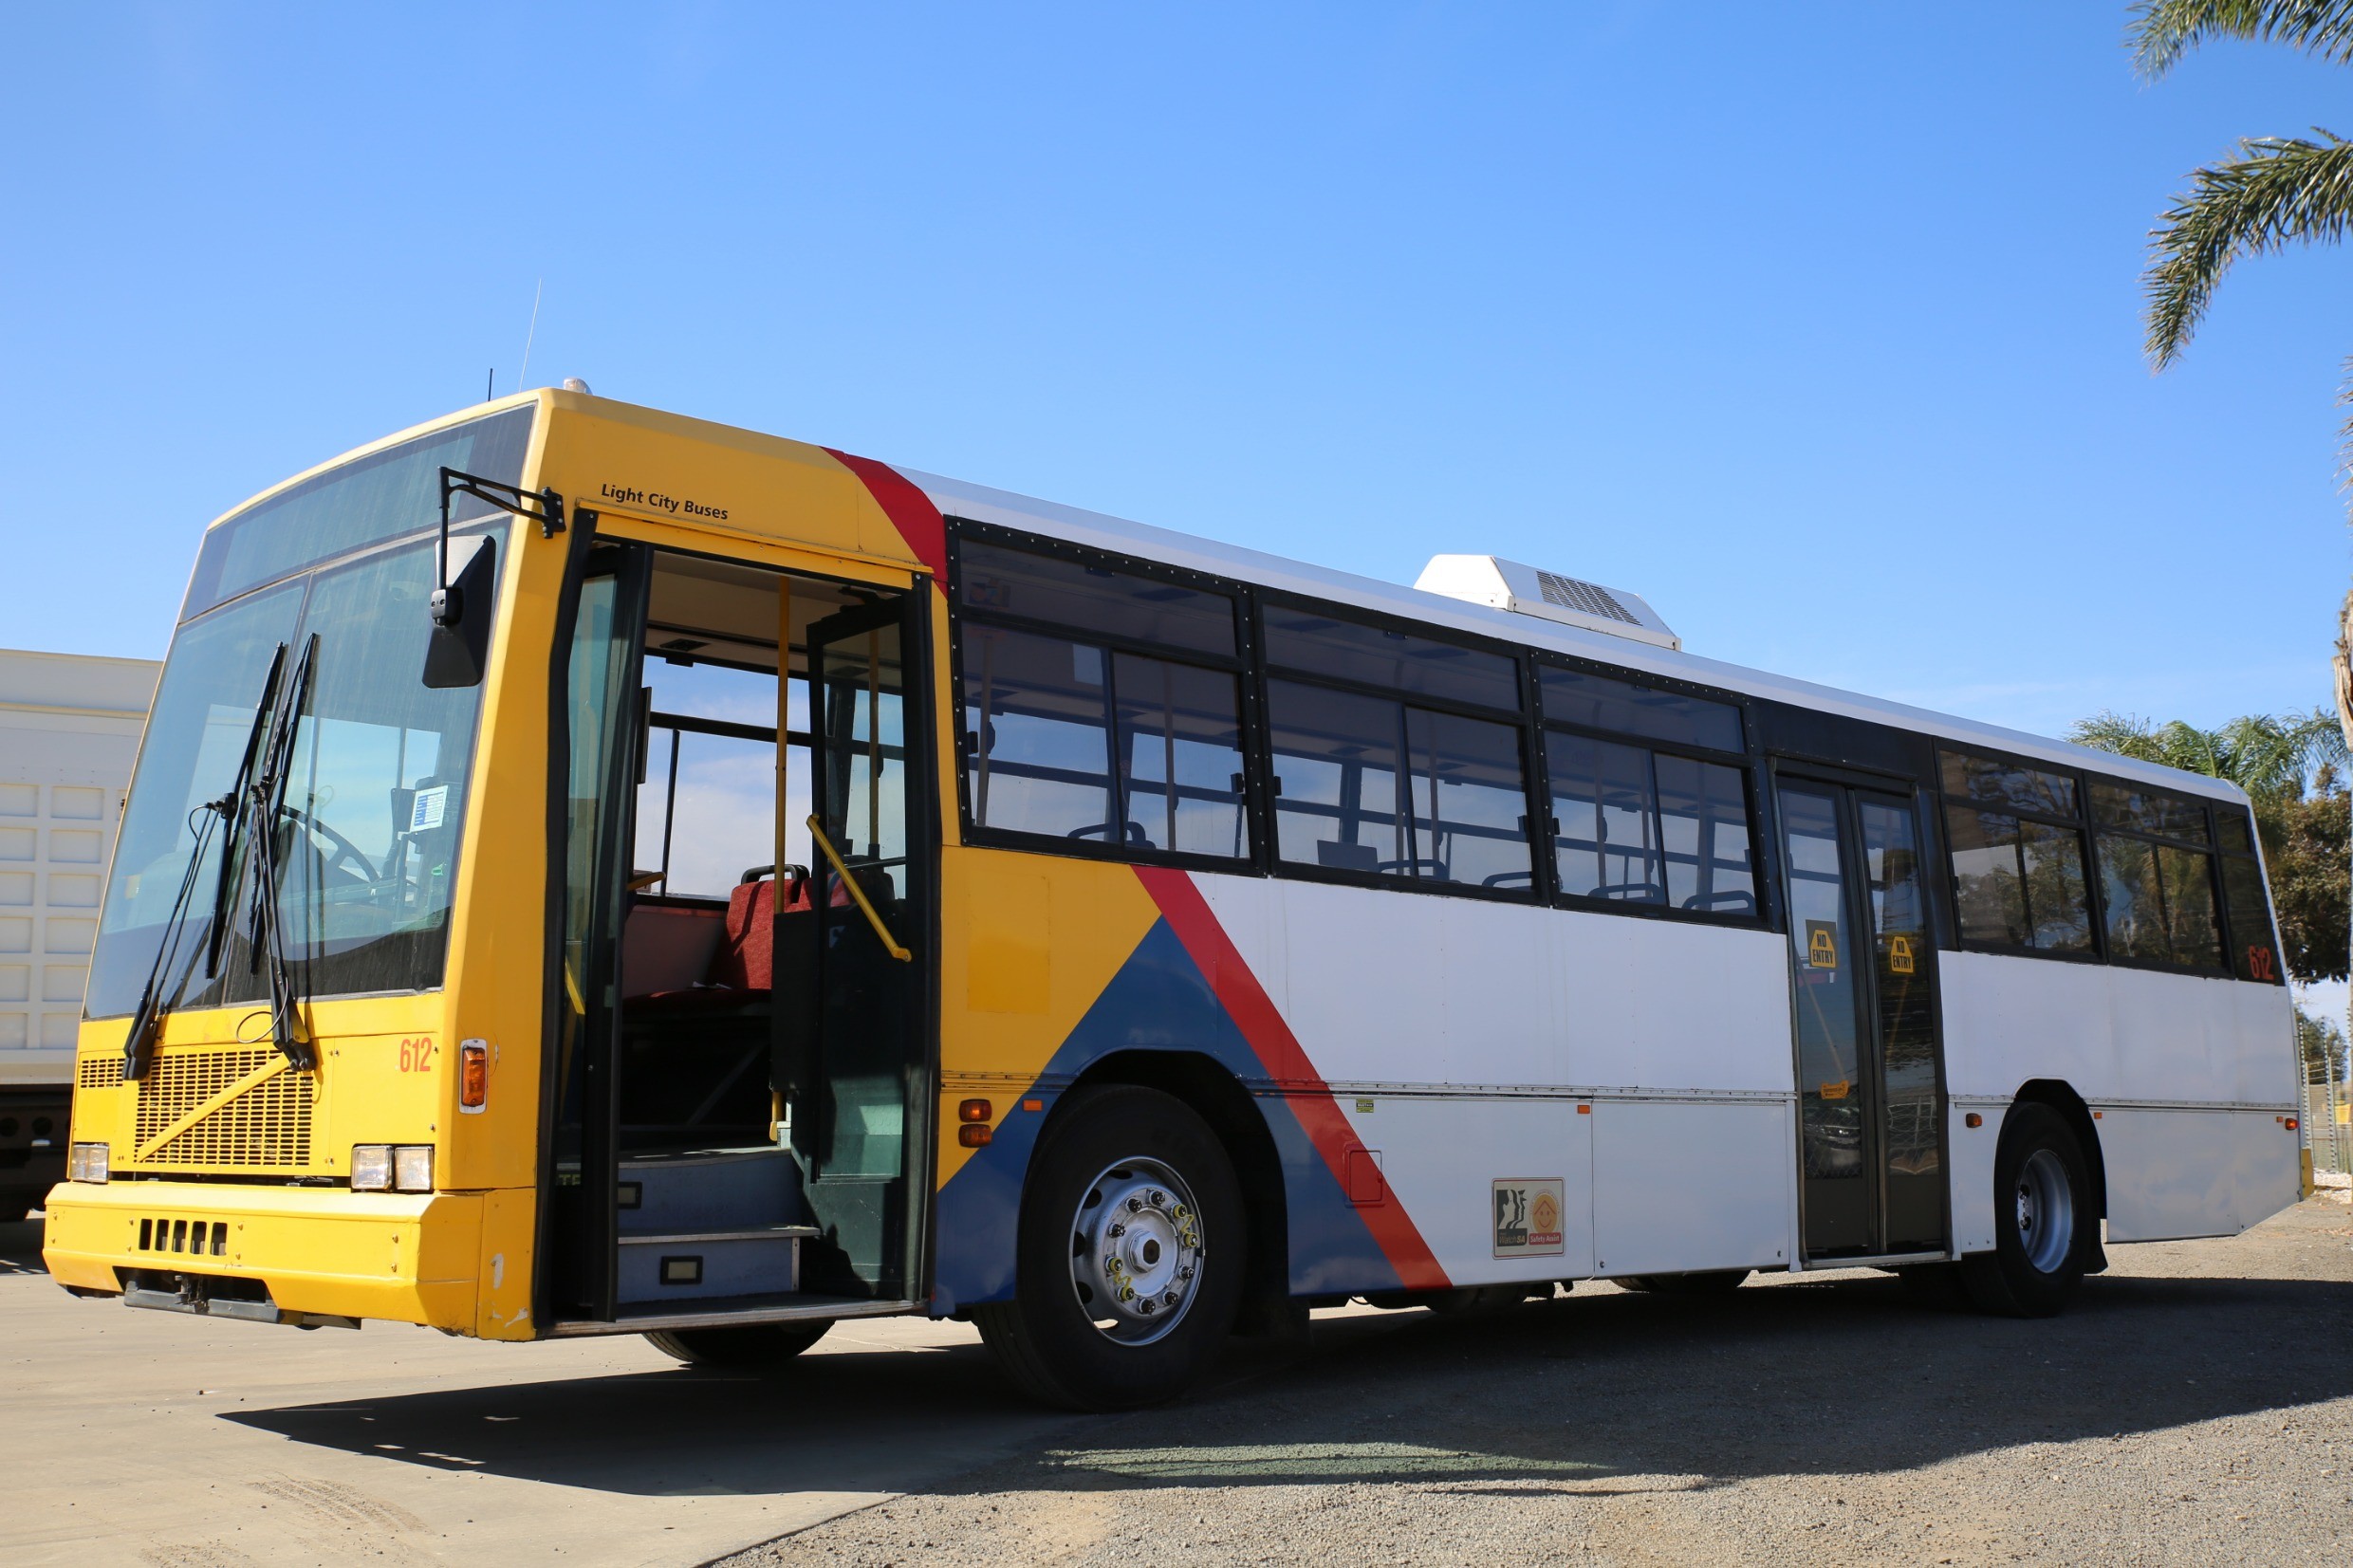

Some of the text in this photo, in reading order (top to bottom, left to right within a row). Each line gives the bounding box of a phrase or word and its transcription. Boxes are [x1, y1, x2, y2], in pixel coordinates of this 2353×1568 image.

[601, 483, 729, 520] Light City Buses
[1816, 933, 1827, 948] NO
[1896, 939, 1905, 953] NO
[1812, 949, 1834, 965] ENTRY
[1893, 954, 1911, 969] ENTRY
[2249, 945, 2275, 981] 612
[399, 1037, 433, 1073] 612
[1529, 1235, 1546, 1244] Safety
